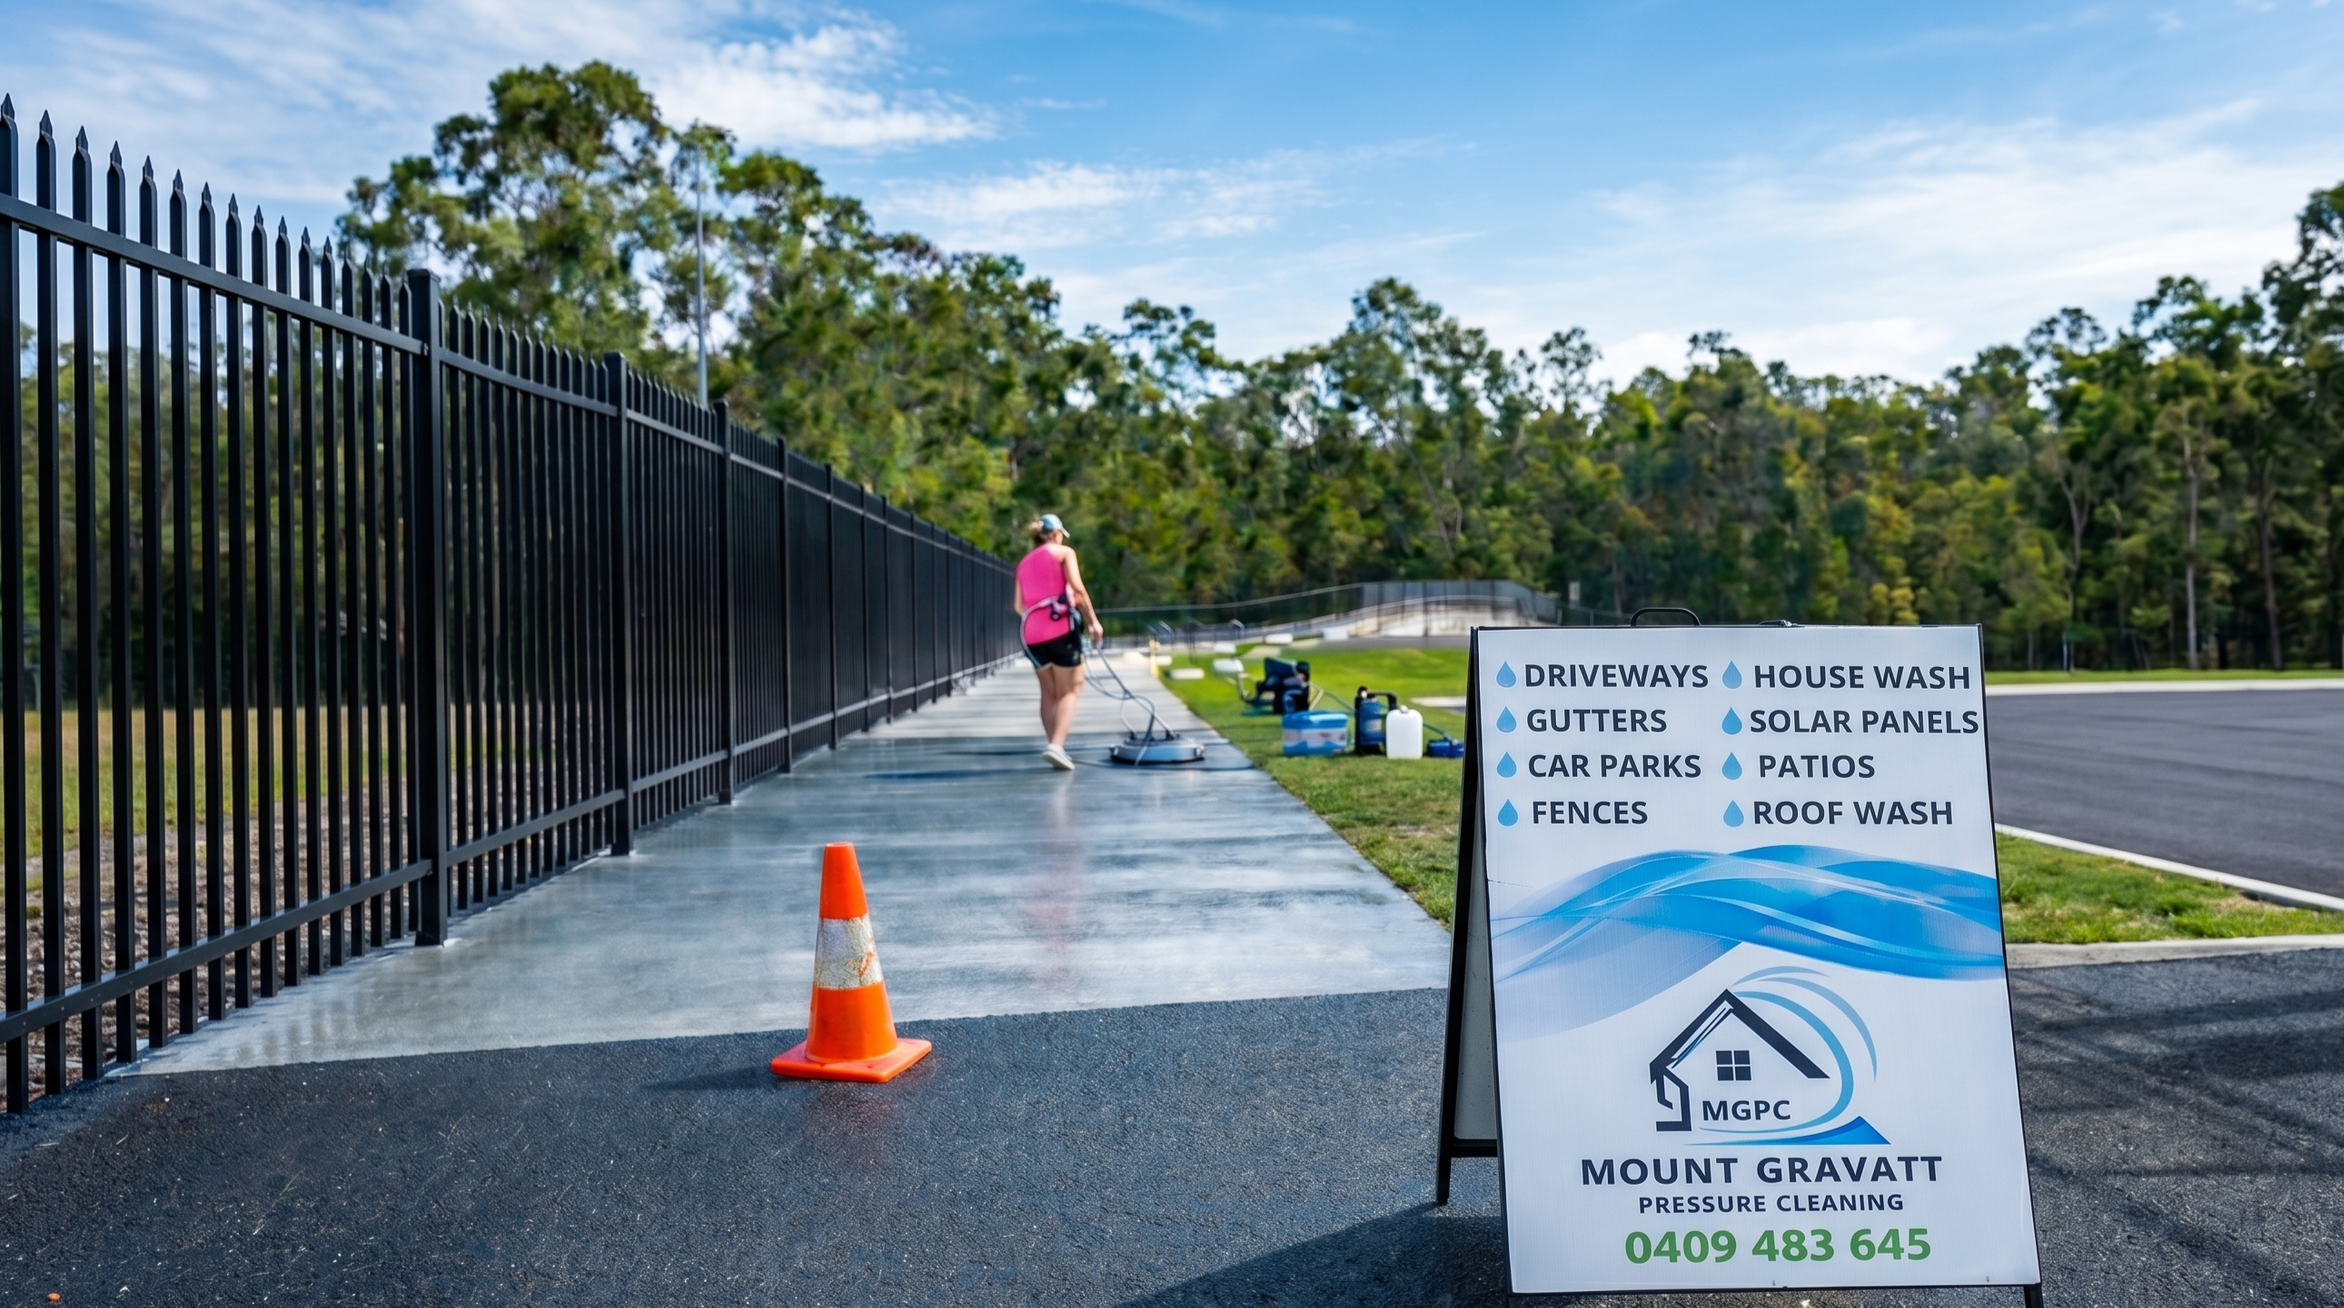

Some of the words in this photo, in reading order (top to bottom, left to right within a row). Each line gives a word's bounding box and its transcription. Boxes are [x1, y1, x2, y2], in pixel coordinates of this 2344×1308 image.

[1524, 663, 1709, 689] DRIVEWAYS
[1754, 664, 1865, 689] HOUSE
[1872, 665, 1970, 690] WASH
[1526, 708, 1667, 733] GUTTERS
[1750, 709, 1853, 734] SOLAR
[1861, 710, 1979, 734] PANELS
[1528, 754, 1591, 778] CAR
[1600, 754, 1702, 779] PARKS
[1759, 754, 1876, 779] PATIOS
[1532, 800, 1648, 825] FENCES
[1753, 800, 1843, 825] ROOF
[1852, 800, 1953, 826] WASH
[1701, 1099, 1791, 1122] MGPC
[1581, 1157, 1739, 1186] MOUNT
[1756, 1155, 1943, 1184] GRAVATT
[1638, 1195, 1767, 1214] PRESSURE
[1776, 1193, 1904, 1213] CLEANING
[1625, 1229, 1737, 1265] 0409
[1751, 1228, 1835, 1262] 483
[1849, 1227, 1931, 1261] 645
